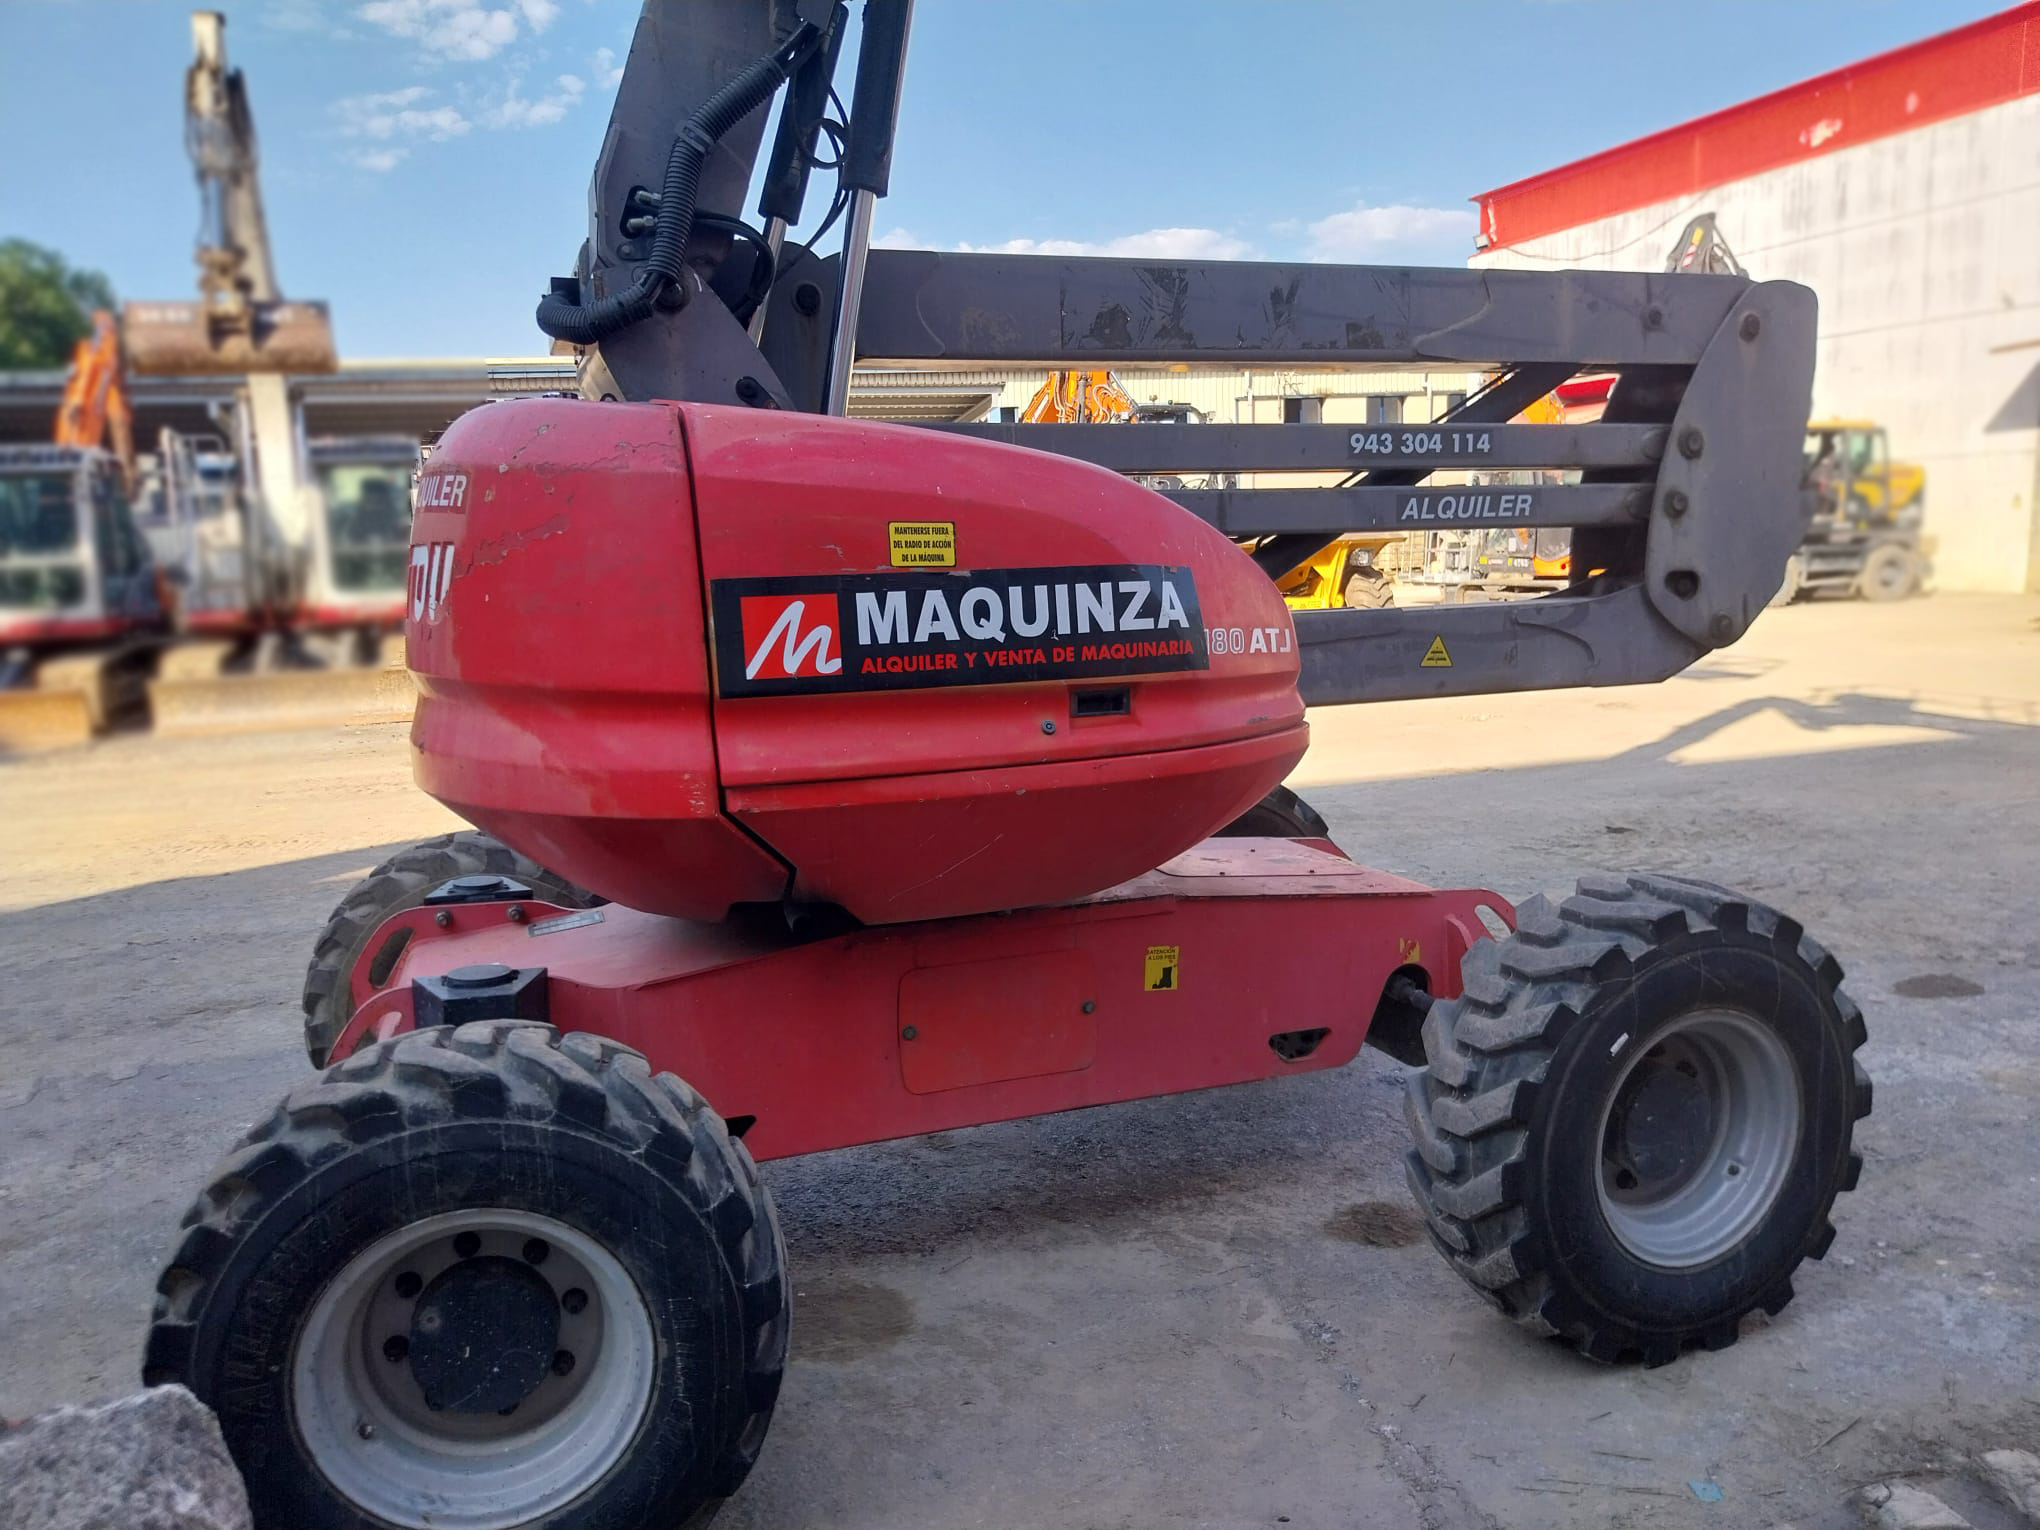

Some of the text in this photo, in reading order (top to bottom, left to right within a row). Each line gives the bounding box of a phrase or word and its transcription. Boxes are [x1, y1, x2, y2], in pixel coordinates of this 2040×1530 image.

[1350, 432, 1491, 454] 943 304 114
[1401, 493, 1533, 520] ALQUILER
[894, 526, 949, 535] MANTENERSE FUERA
[893, 541, 903, 549] DEL
[904, 541, 922, 549] RADIO
[923, 541, 930, 549] DE
[902, 553, 909, 562] DE
[911, 553, 917, 562] LA
[855, 581, 1190, 645] MAQUINZA
[1249, 627, 1291, 654] ATJ
[861, 639, 1194, 674] ALQUILER Y VENTA DE MAQUINARIA
